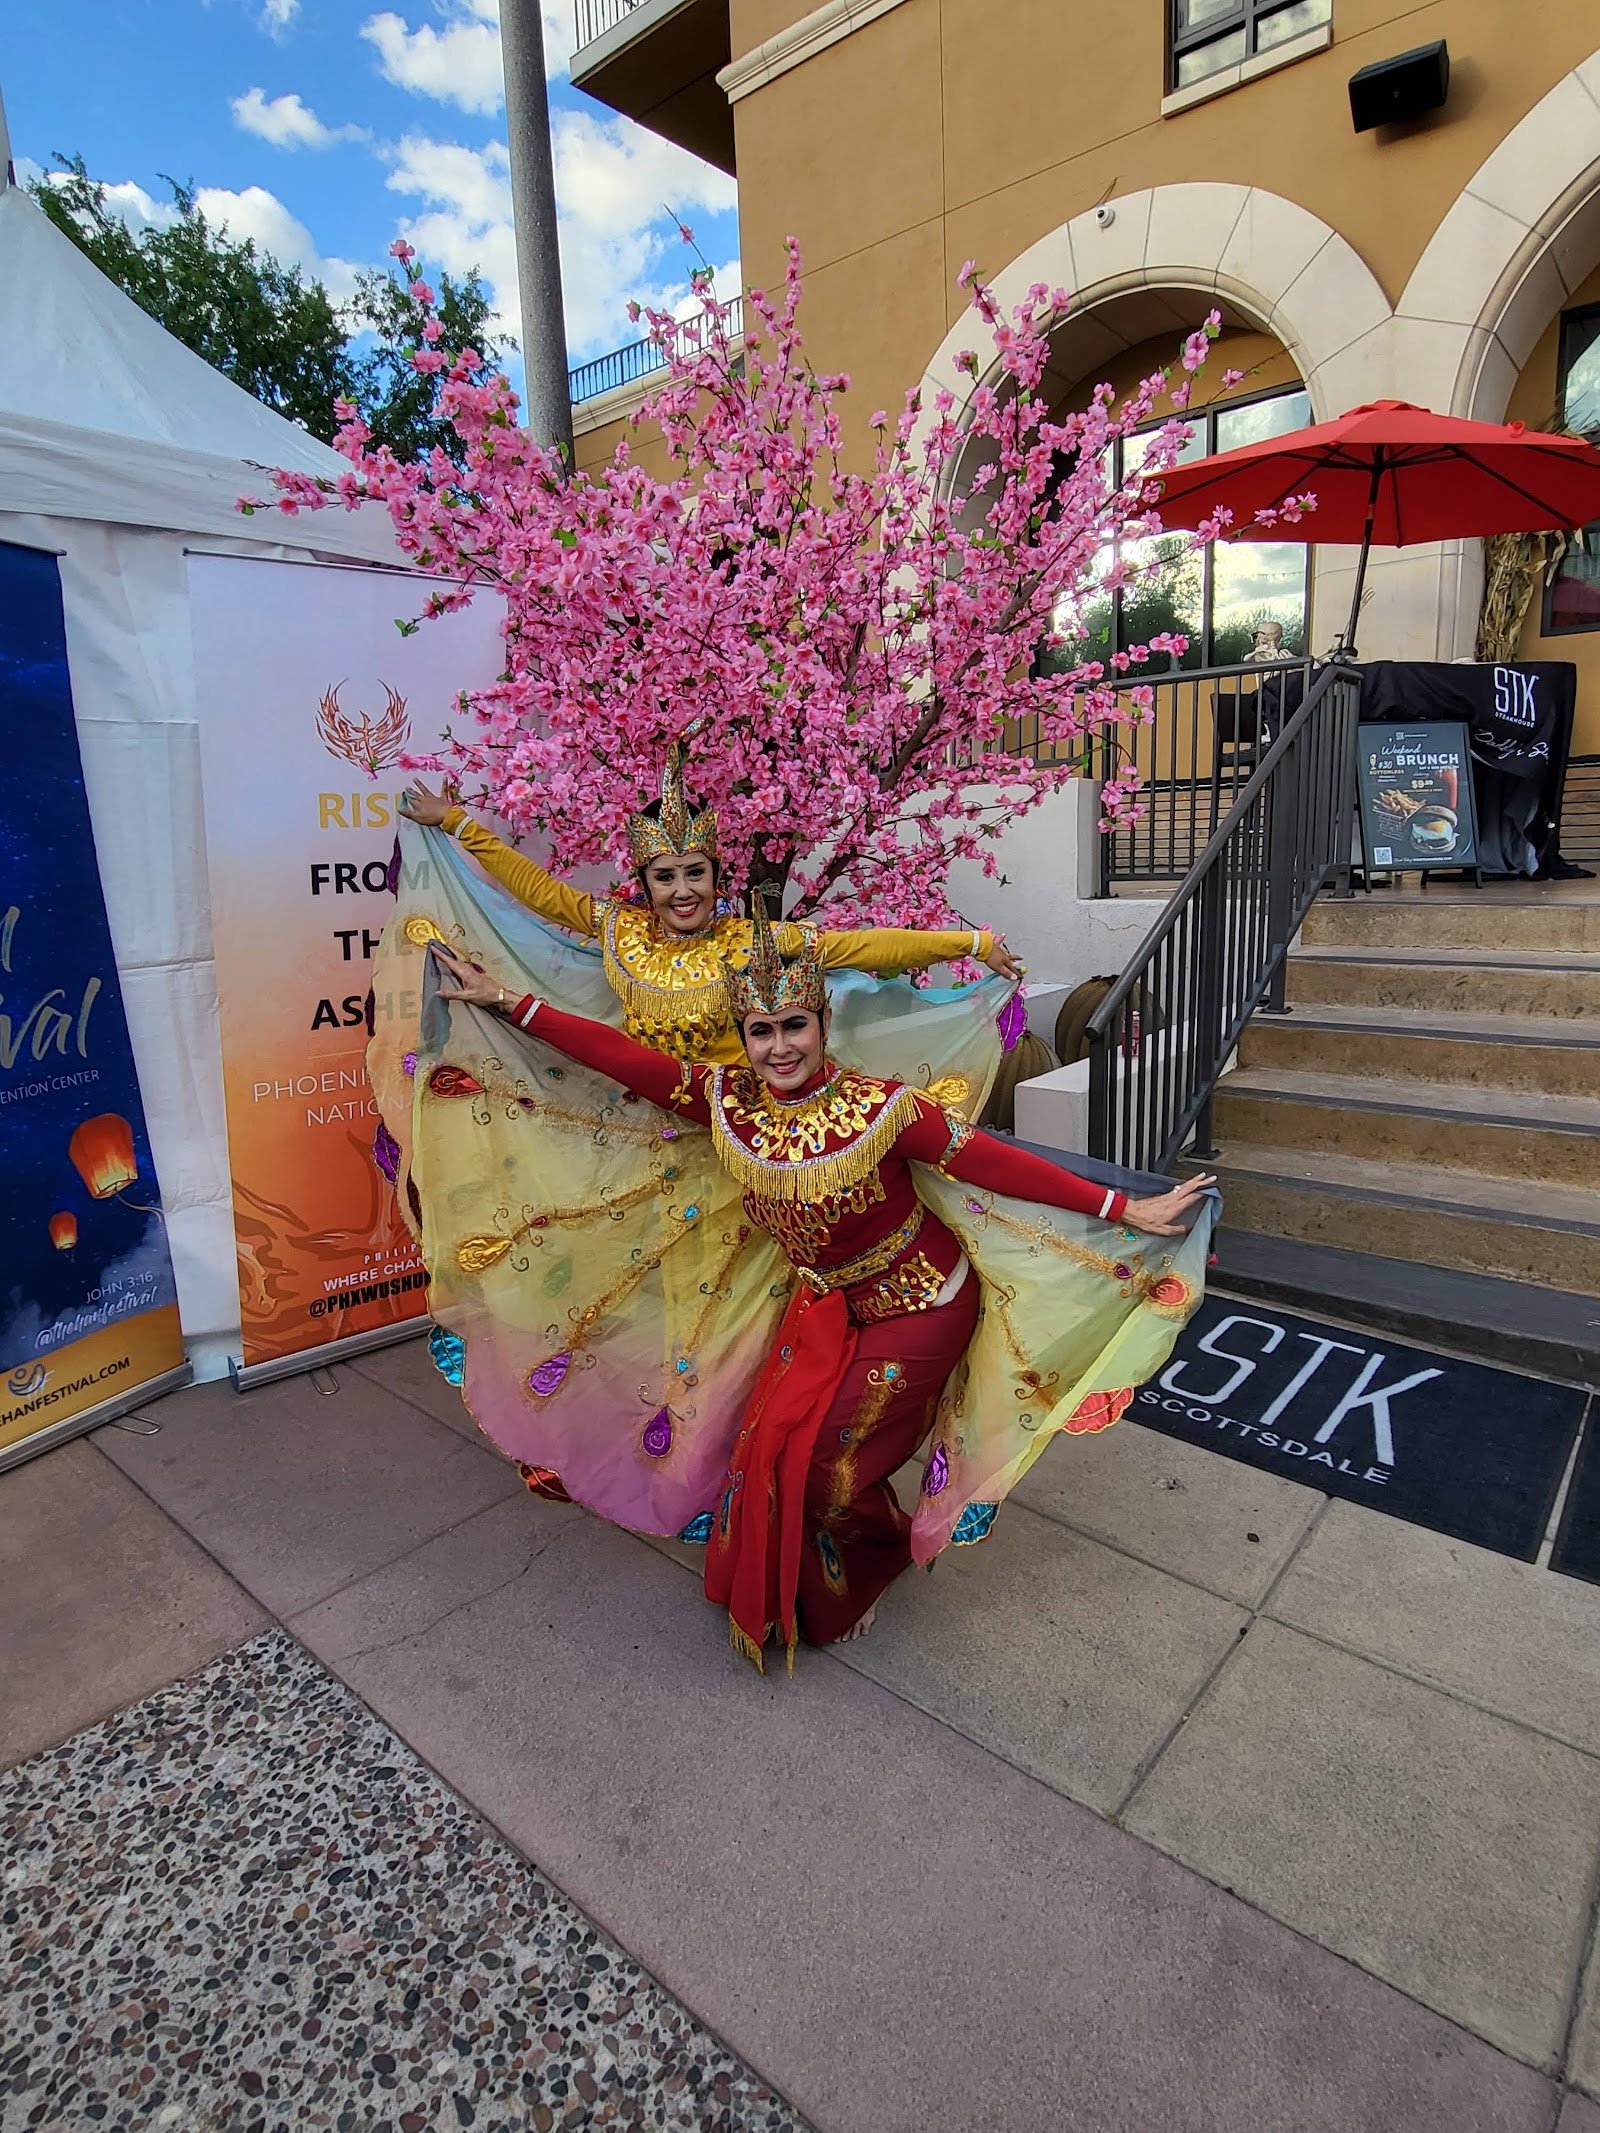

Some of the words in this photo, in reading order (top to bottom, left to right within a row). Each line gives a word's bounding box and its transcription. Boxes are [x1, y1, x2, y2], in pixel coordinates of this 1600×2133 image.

[1493, 666, 1537, 722] STK
[1494, 711, 1535, 729] STEAKHOUSE
[1381, 743, 1422, 755] Weekend
[1396, 753, 1459, 766] BRUNCH
[310, 860, 430, 896] FROM
[0, 976, 102, 1069] val
[310, 989, 424, 1031] ASHE
[51, 1069, 100, 1090] CENTER
[86, 1279, 123, 1304] JOHN
[127, 1270, 154, 1288] 3:16
[323, 1267, 379, 1292] WHERE
[34, 1285, 158, 1350] @thehanfestival
[0, 1356, 130, 1427] HANFESTIVAL.COM
[1159, 1315, 1445, 1466] STK
[1138, 1390, 1393, 1486] SCOTTSDALE
